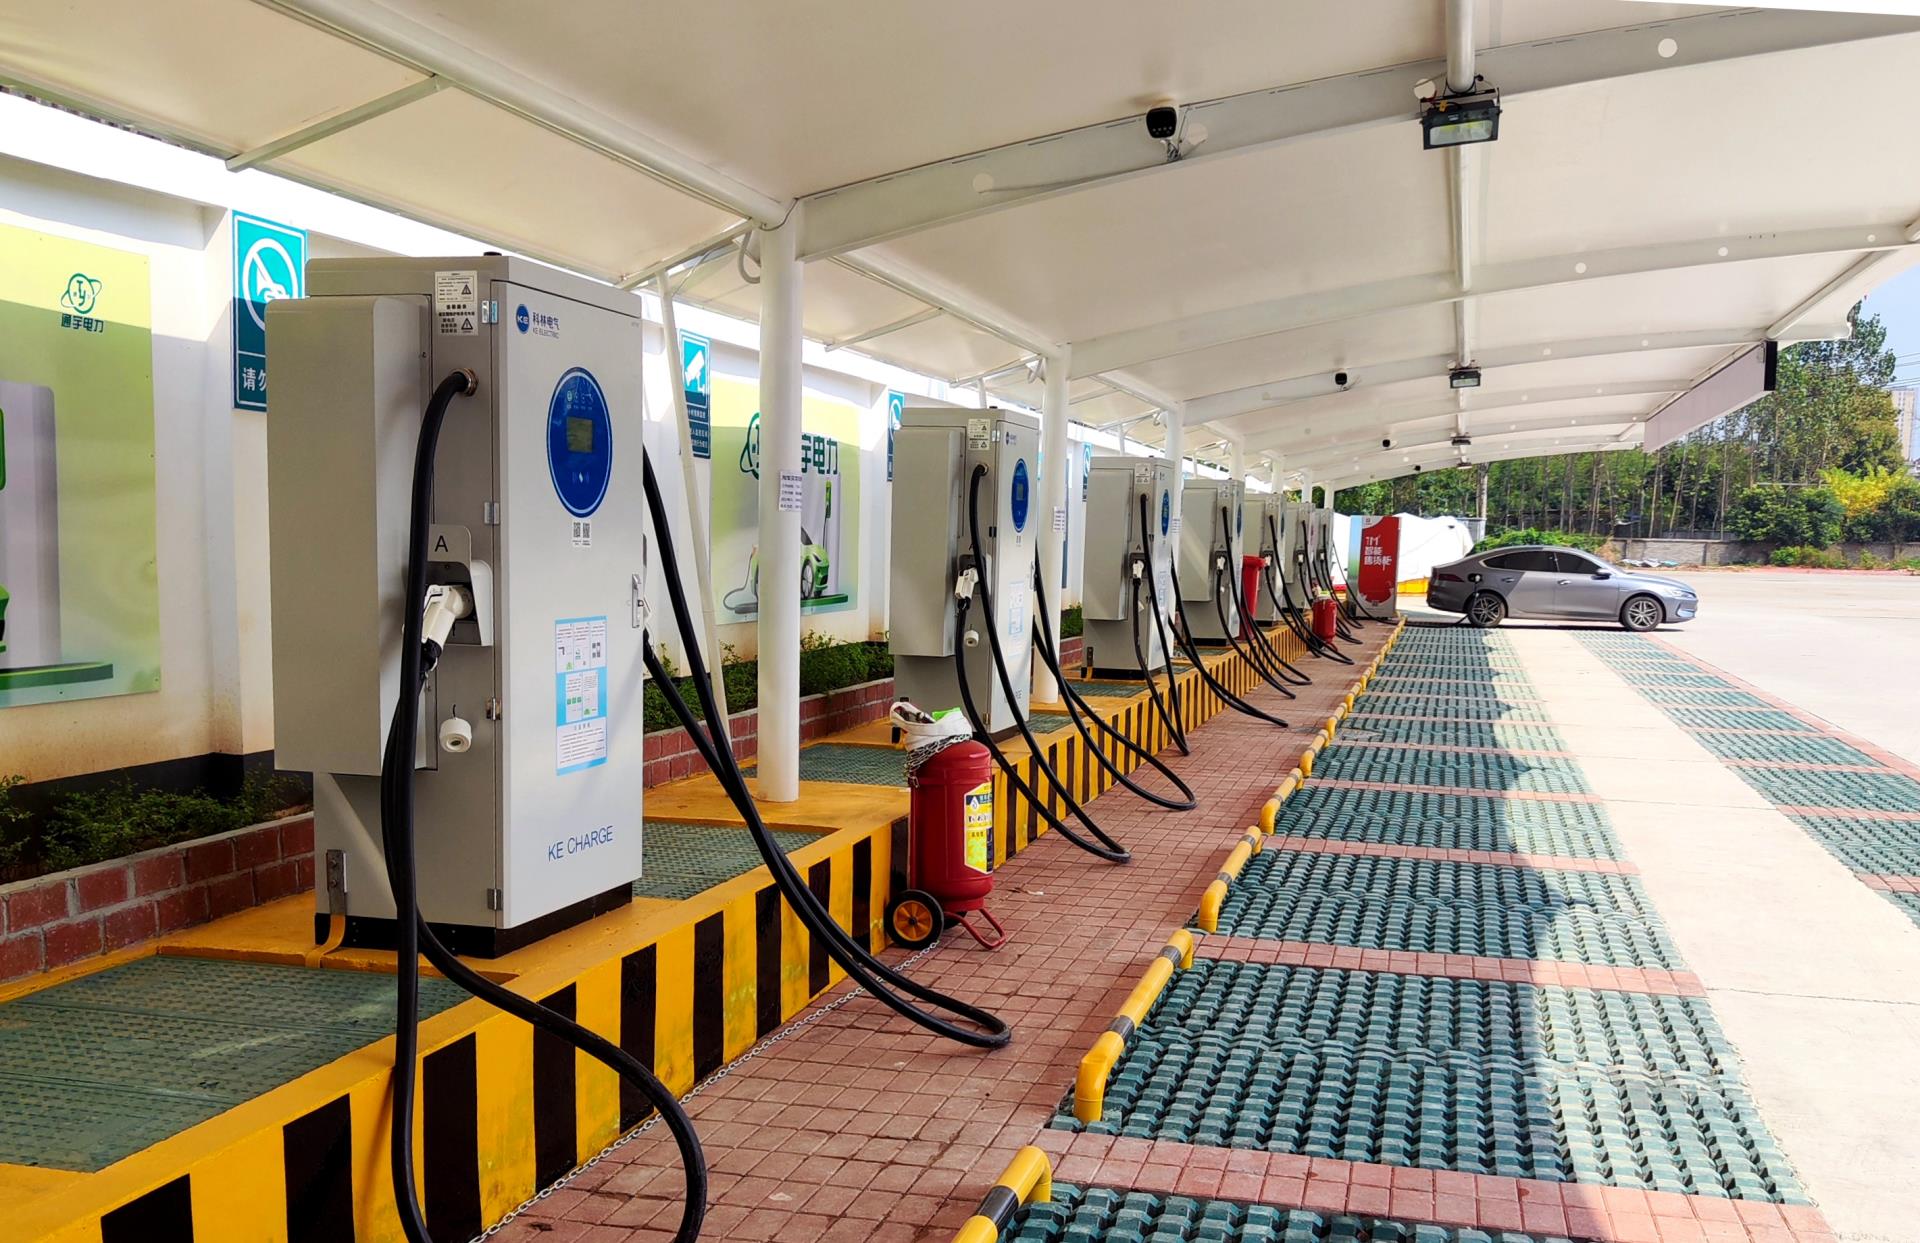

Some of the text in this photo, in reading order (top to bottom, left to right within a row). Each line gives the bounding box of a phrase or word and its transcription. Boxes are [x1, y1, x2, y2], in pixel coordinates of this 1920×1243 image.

[61, 313, 104, 333] 通宇电力
[532, 311, 560, 331] 科林电气
[434, 535, 449, 552] A
[548, 825, 614, 862] KE CHARGE
